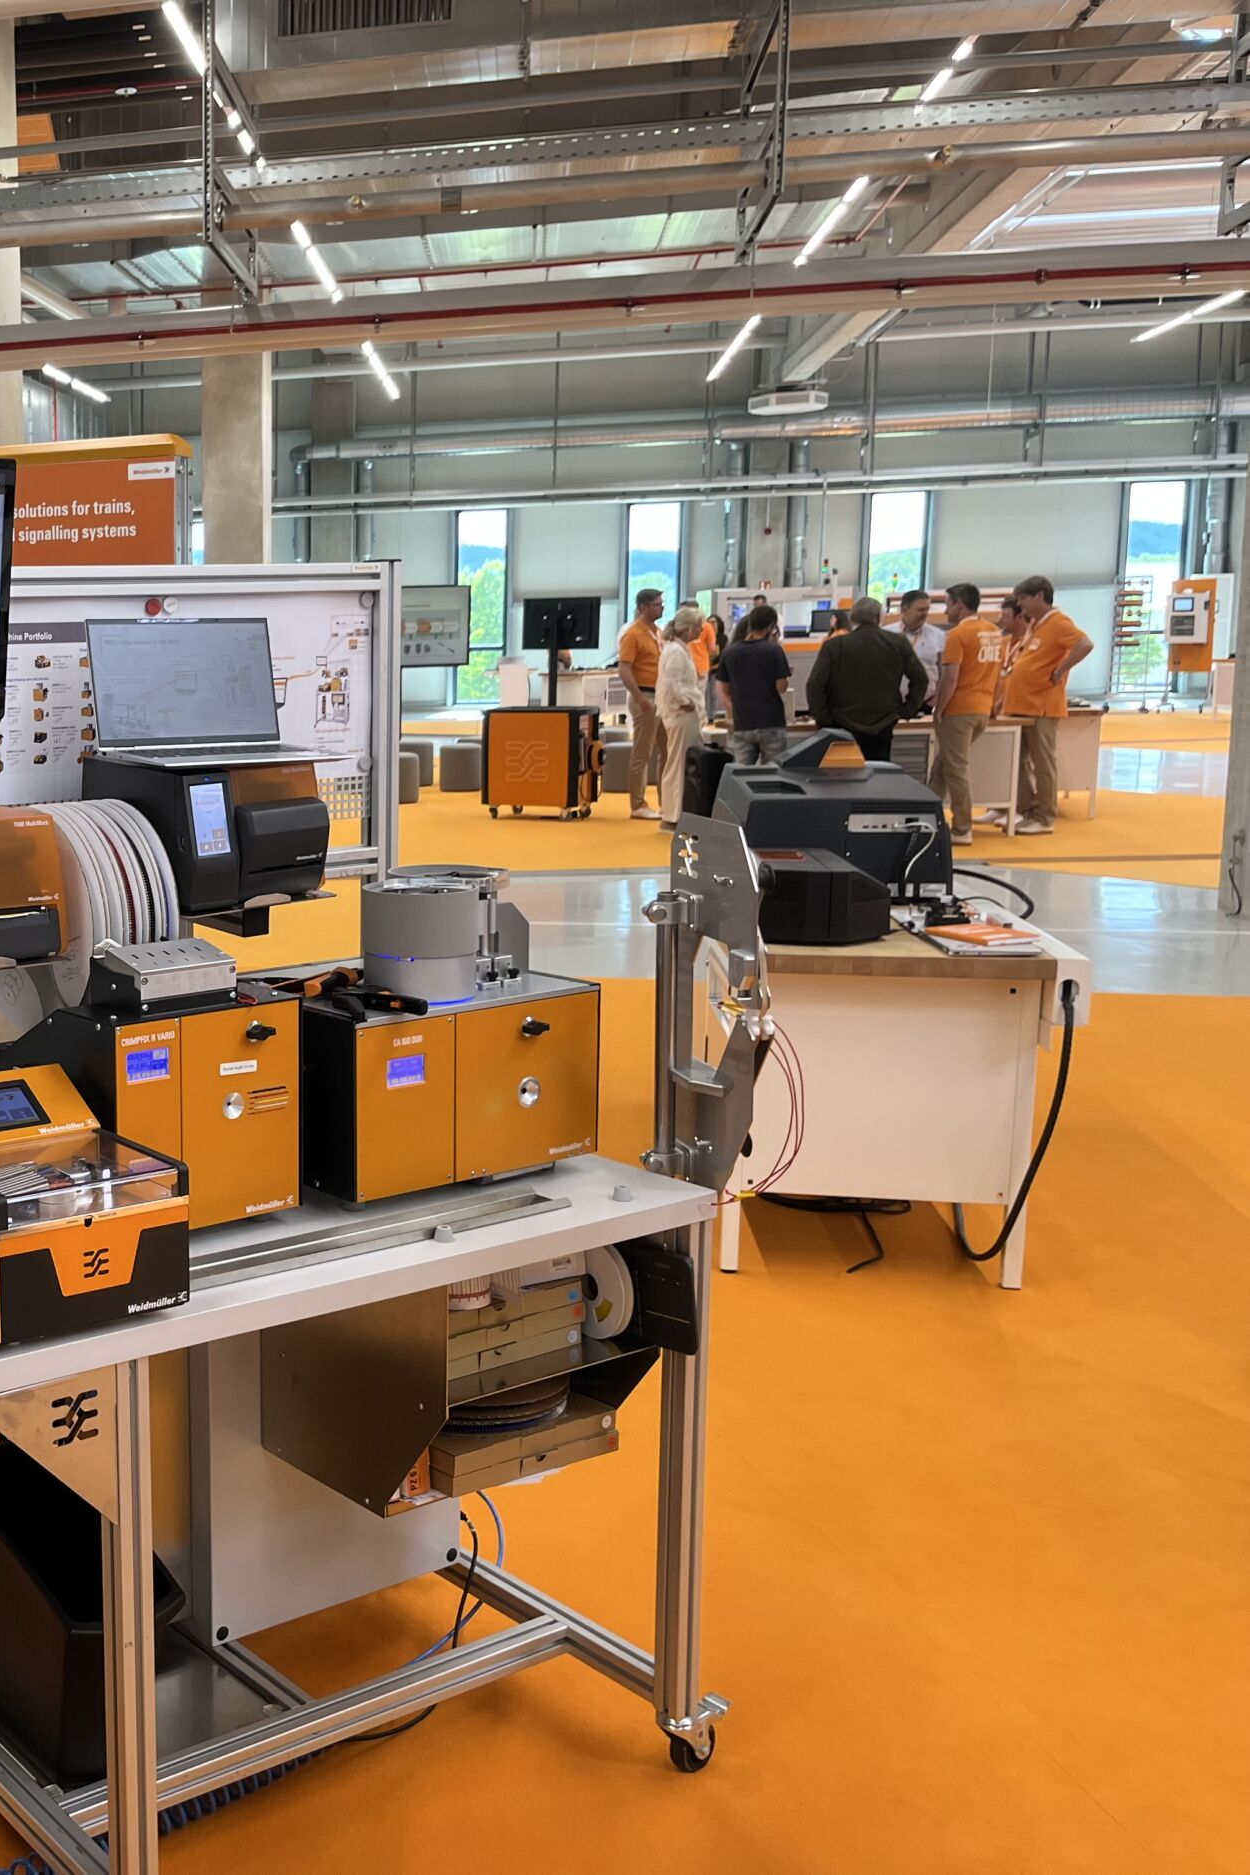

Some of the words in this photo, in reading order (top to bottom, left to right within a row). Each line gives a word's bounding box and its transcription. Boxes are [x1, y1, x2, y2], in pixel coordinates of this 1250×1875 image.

[14, 502, 69, 518] solutions
[72, 500, 90, 516] for
[93, 499, 135, 516] trains,
[18, 524, 79, 544] signalling
[82, 524, 137, 542] systems
[24, 630, 53, 641] Portfolio
[121, 1034, 150, 1047] CRIMPFIX
[157, 1031, 175, 1041] VARIO
[38, 1122, 85, 1134] Weidmüller
[245, 1200, 285, 1213] Weidmüller
[128, 1296, 177, 1314] Weidmüller
